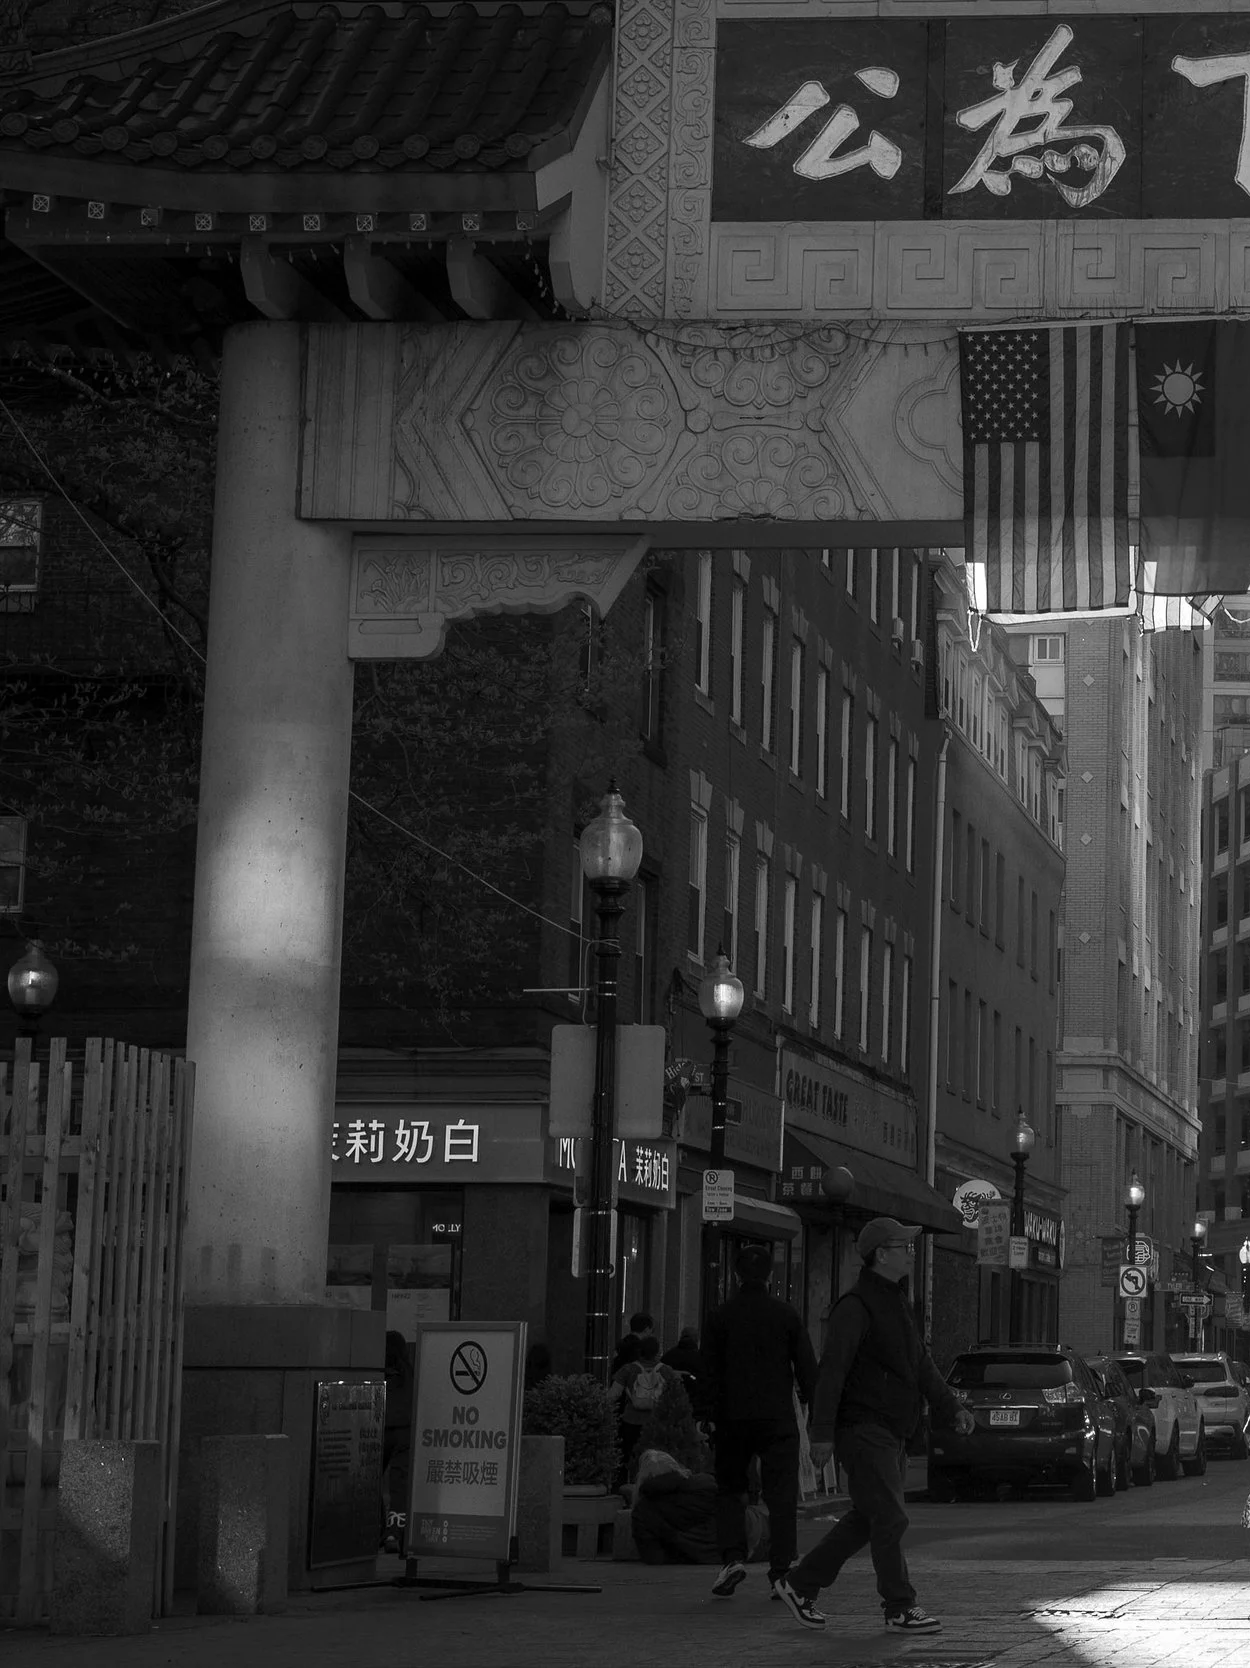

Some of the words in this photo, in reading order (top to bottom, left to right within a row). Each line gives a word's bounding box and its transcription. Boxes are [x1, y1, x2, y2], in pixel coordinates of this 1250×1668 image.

[786, 1068, 820, 1115] GREAT
[822, 1084, 849, 1126] TASTE
[634, 1145, 670, 1192] 茉莉奶白
[451, 1405, 480, 1425] NO
[421, 1428, 508, 1450] SMOKING
[425, 1458, 499, 1487] 嚴禁吸煙
